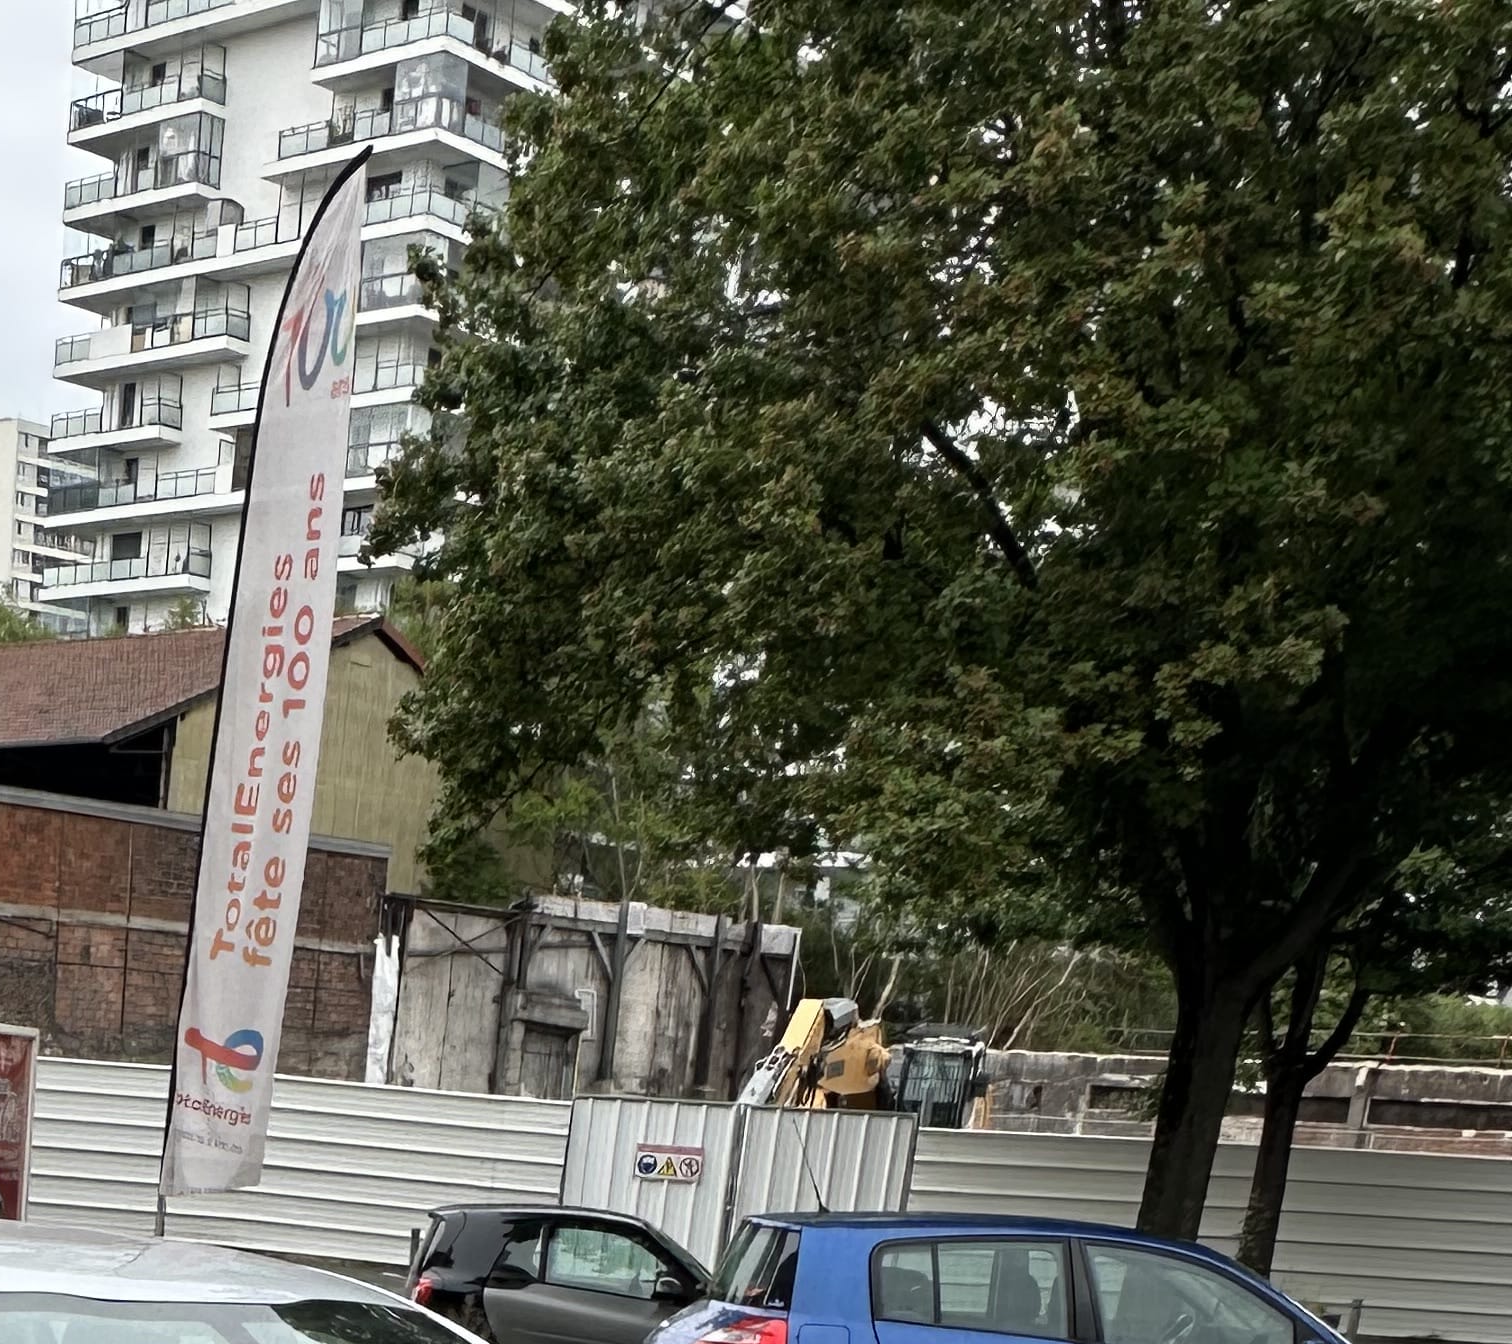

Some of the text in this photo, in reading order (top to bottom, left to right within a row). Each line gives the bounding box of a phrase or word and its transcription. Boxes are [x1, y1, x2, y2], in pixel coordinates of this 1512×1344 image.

[209, 552, 293, 962] TotalEnergies
[243, 472, 326, 968] fête ses 100 ans
